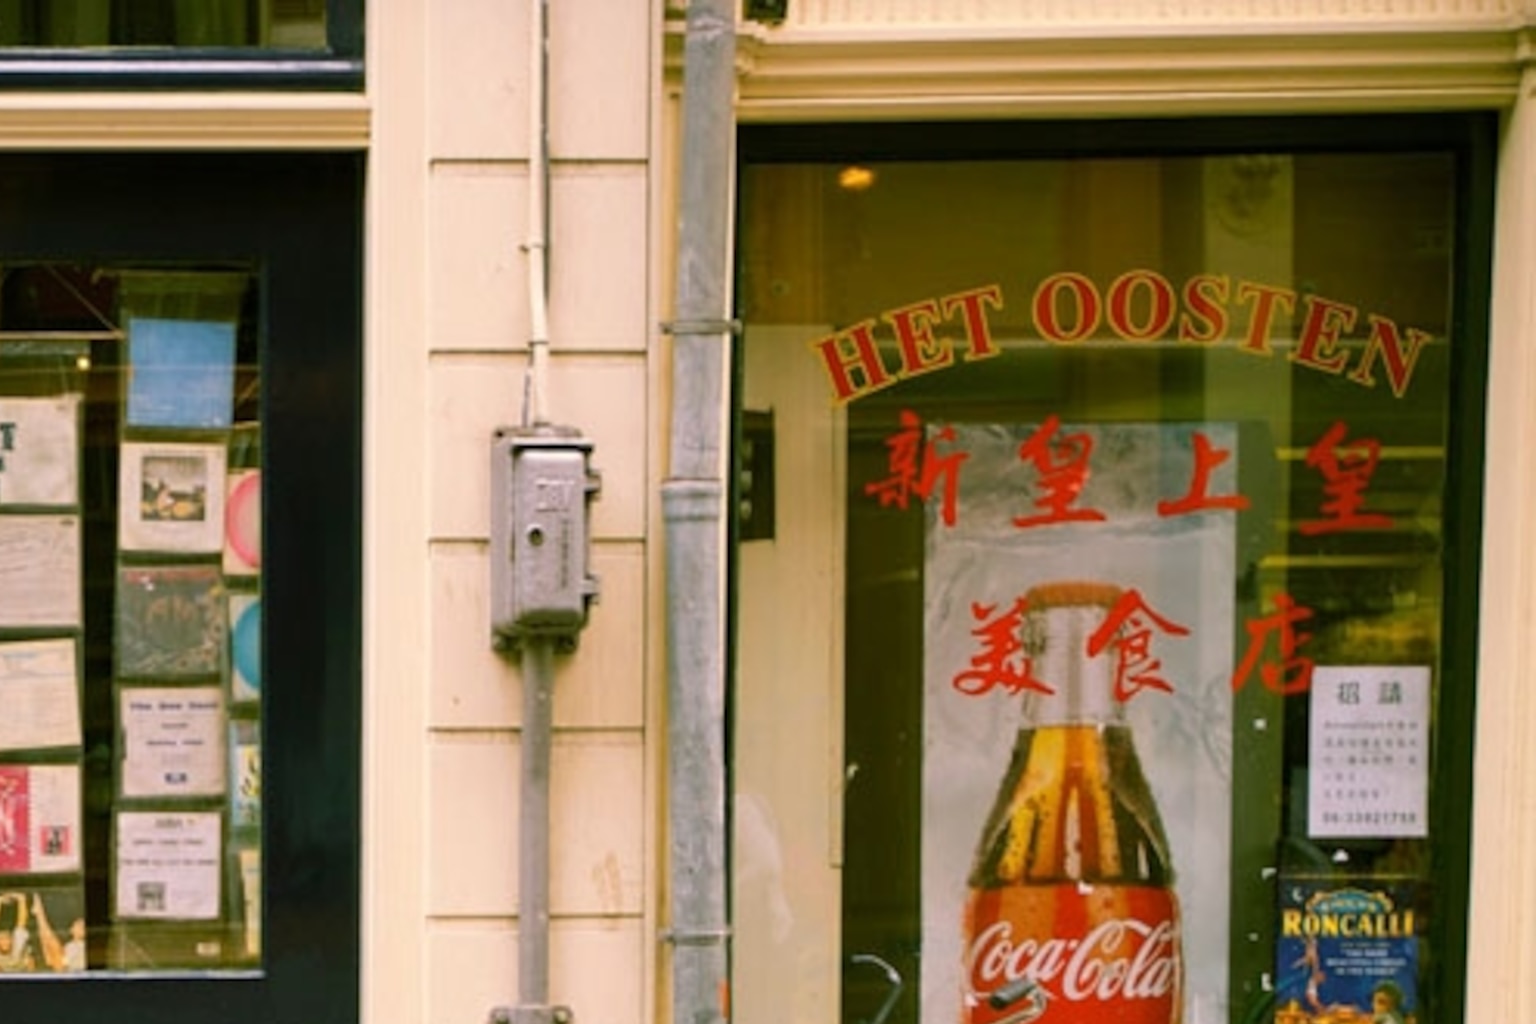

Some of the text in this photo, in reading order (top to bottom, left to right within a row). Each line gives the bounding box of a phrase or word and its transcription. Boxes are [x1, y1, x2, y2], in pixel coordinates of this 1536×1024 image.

[816, 271, 1431, 404] HET OOSTEN
[953, 589, 1314, 701] 美食店
[1282, 908, 1414, 938] RONCALLI
